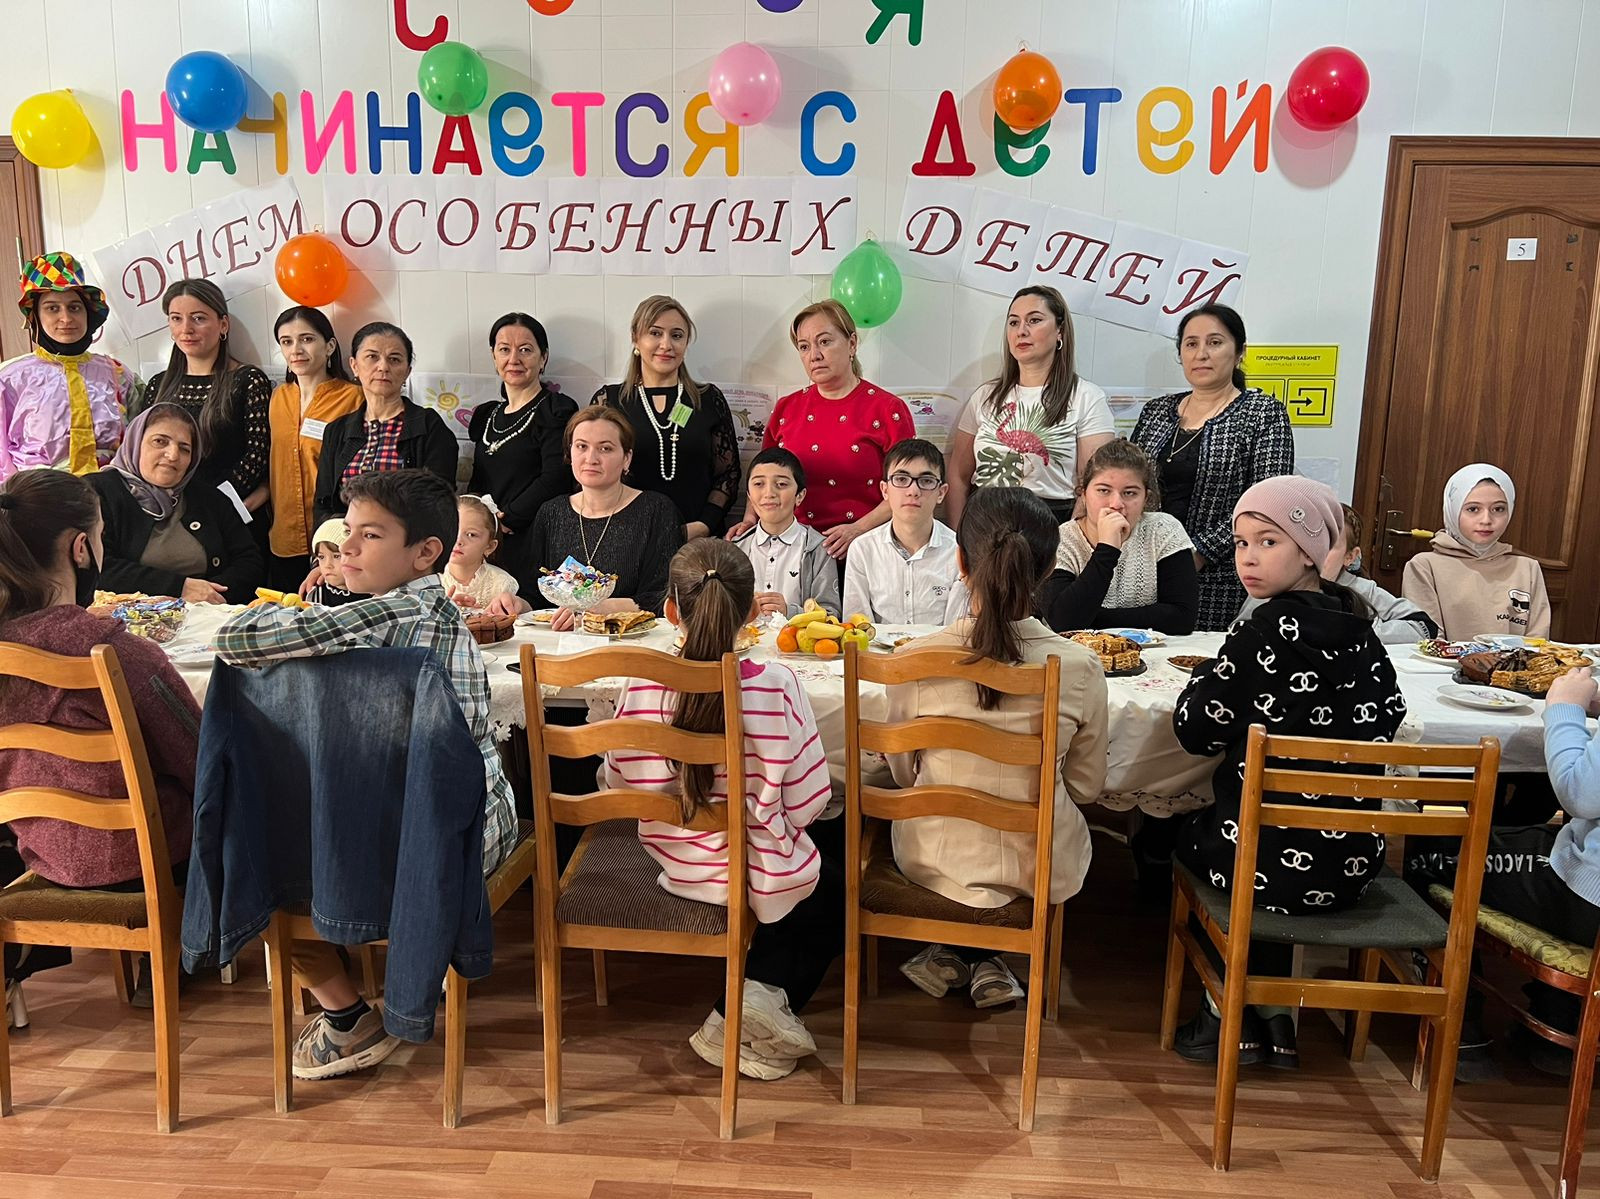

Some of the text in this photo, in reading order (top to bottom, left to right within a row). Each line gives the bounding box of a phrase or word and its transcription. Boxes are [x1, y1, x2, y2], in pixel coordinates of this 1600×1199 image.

[801, 92, 856, 177] С
[121, 196, 1242, 315] ДНЕМ ОСОБЕННЫХ ДЕТЕЙ
[1517, 243, 1527, 257] 5
[1485, 853, 1534, 873] LACOS
